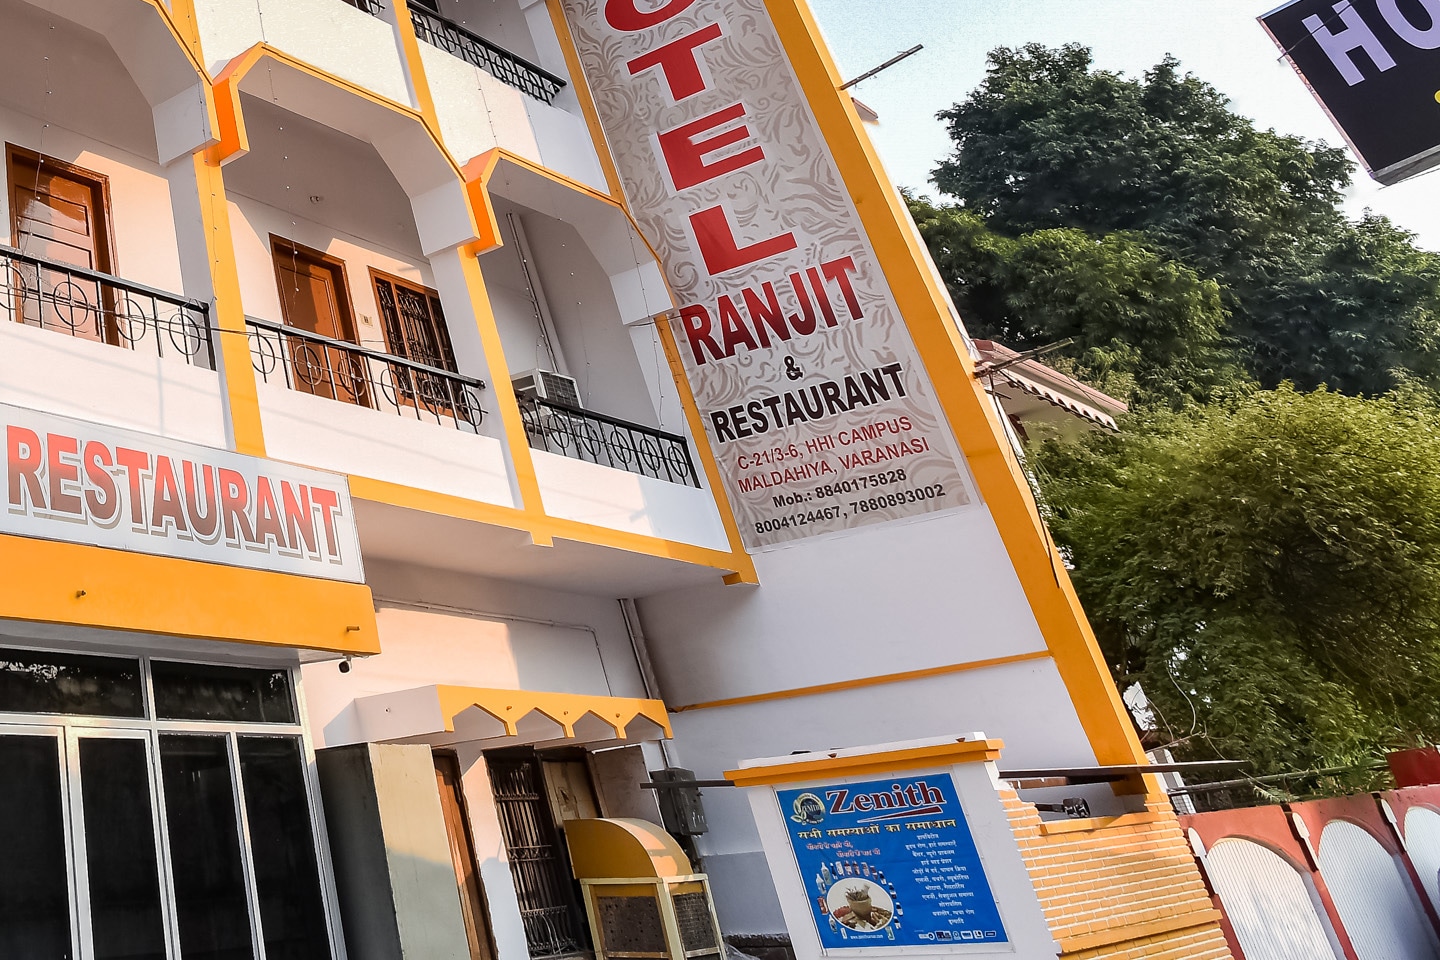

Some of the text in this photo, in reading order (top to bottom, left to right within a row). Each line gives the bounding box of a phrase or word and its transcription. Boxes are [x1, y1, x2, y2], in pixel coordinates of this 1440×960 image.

[680, 256, 864, 366] RANJIT
[784, 355, 804, 381] &
[710, 362, 908, 444] RESTAURANT
[737, 416, 913, 470] C-21/3-6, HHI CAMPUS
[738, 437, 930, 493] MALDAHIYA, VARANASI
[7, 424, 343, 564] RESTAURANT
[755, 483, 946, 534] 8004124467, 7880893002
[772, 468, 907, 508] Mob.: 8840175828
[826, 781, 947, 815] Zenith
[798, 819, 957, 839] सभी समस्याओं का समाधान
